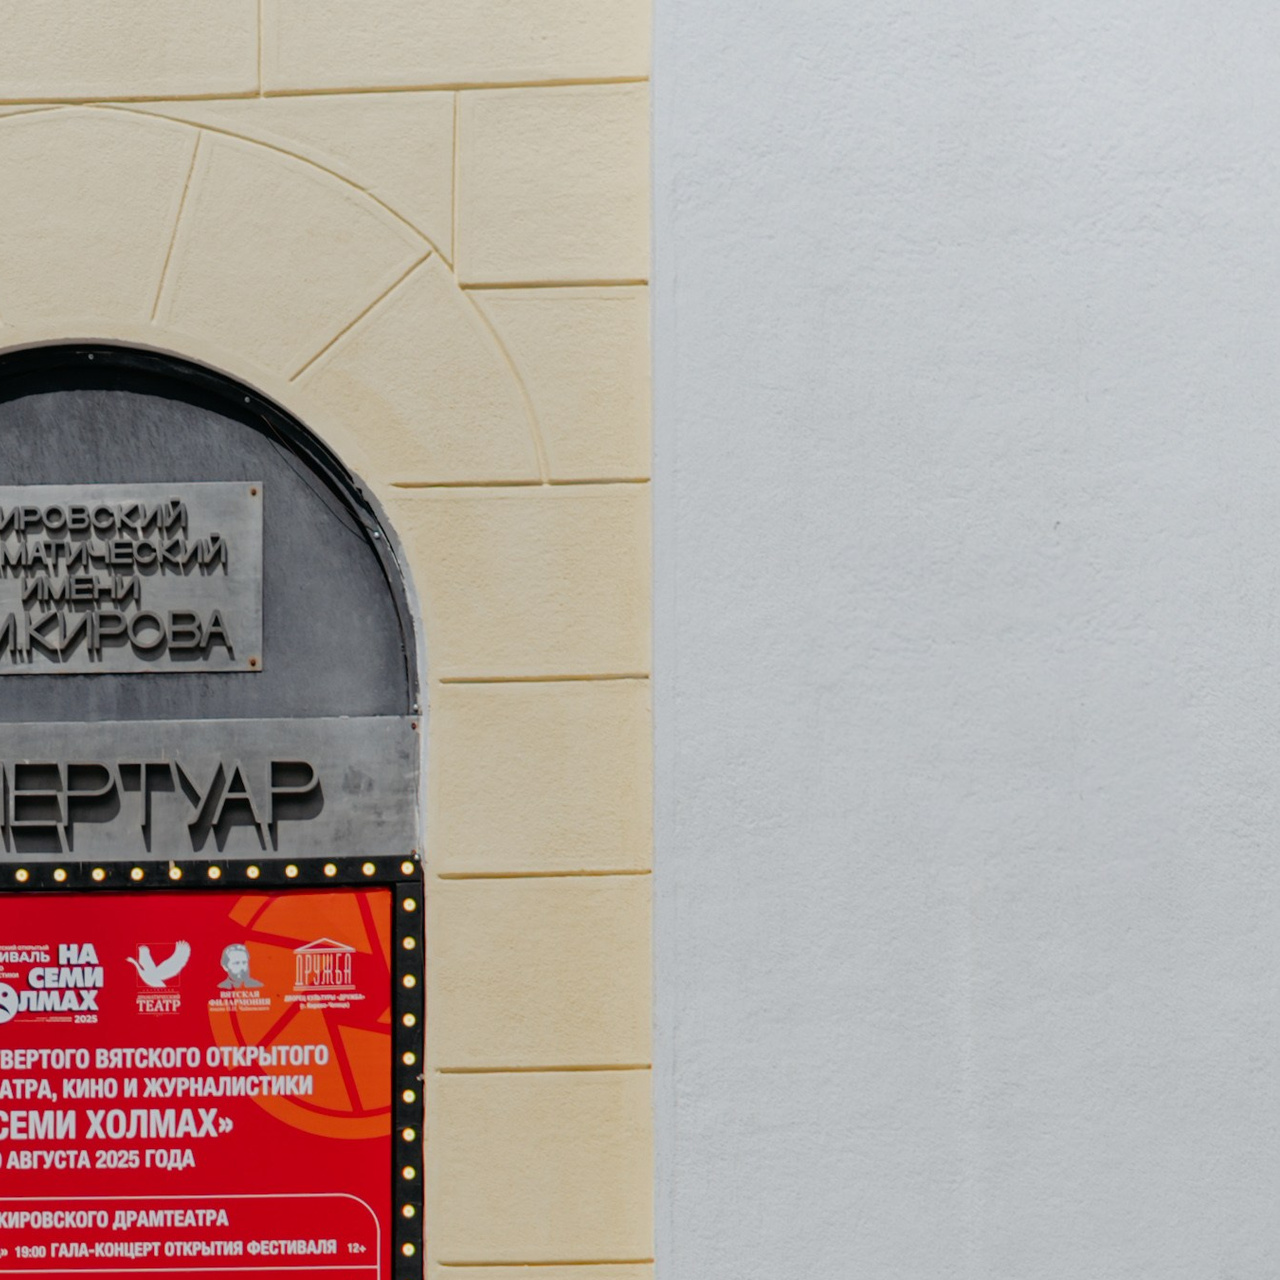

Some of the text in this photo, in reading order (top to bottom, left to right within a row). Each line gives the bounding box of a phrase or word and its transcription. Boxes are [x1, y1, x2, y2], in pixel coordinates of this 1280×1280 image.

[21, 574, 140, 605] ИМЕНИ
[58, 943, 99, 965] НА
[28, 966, 104, 989] СЕМИ
[295, 953, 352, 986] ДРУЖБА
[136, 999, 181, 1012] ТЕАТР
[208, 998, 271, 1007] ФИЛАРМОНИЯ
[74, 1014, 98, 1024] 2025
[95, 1047, 201, 1069] ВЯТСКОГО
[206, 1044, 329, 1067] ОТКРЫТОГО
[63, 1078, 118, 1099] КИНО
[124, 1078, 138, 1098] И
[143, 1075, 313, 1098] ЖУРНАЛИСТИКИ
[86, 1108, 233, 1139] ХОЛМАХ»
[6, 1150, 91, 1169] АВГУСТА
[95, 1150, 140, 1169] 2025
[145, 1149, 195, 1171] ГОДА
[112, 1209, 229, 1230] ДРАМТЕАТРА
[15, 1246, 46, 1258] 19:00
[51, 1242, 161, 1259] ГАЛА-КОНЦЕРТ
[164, 1240, 243, 1257] ОТКРЫТИЯ
[247, 1239, 337, 1255] ФЕСТИВАЛЯ
[347, 1242, 366, 1253] 12+
